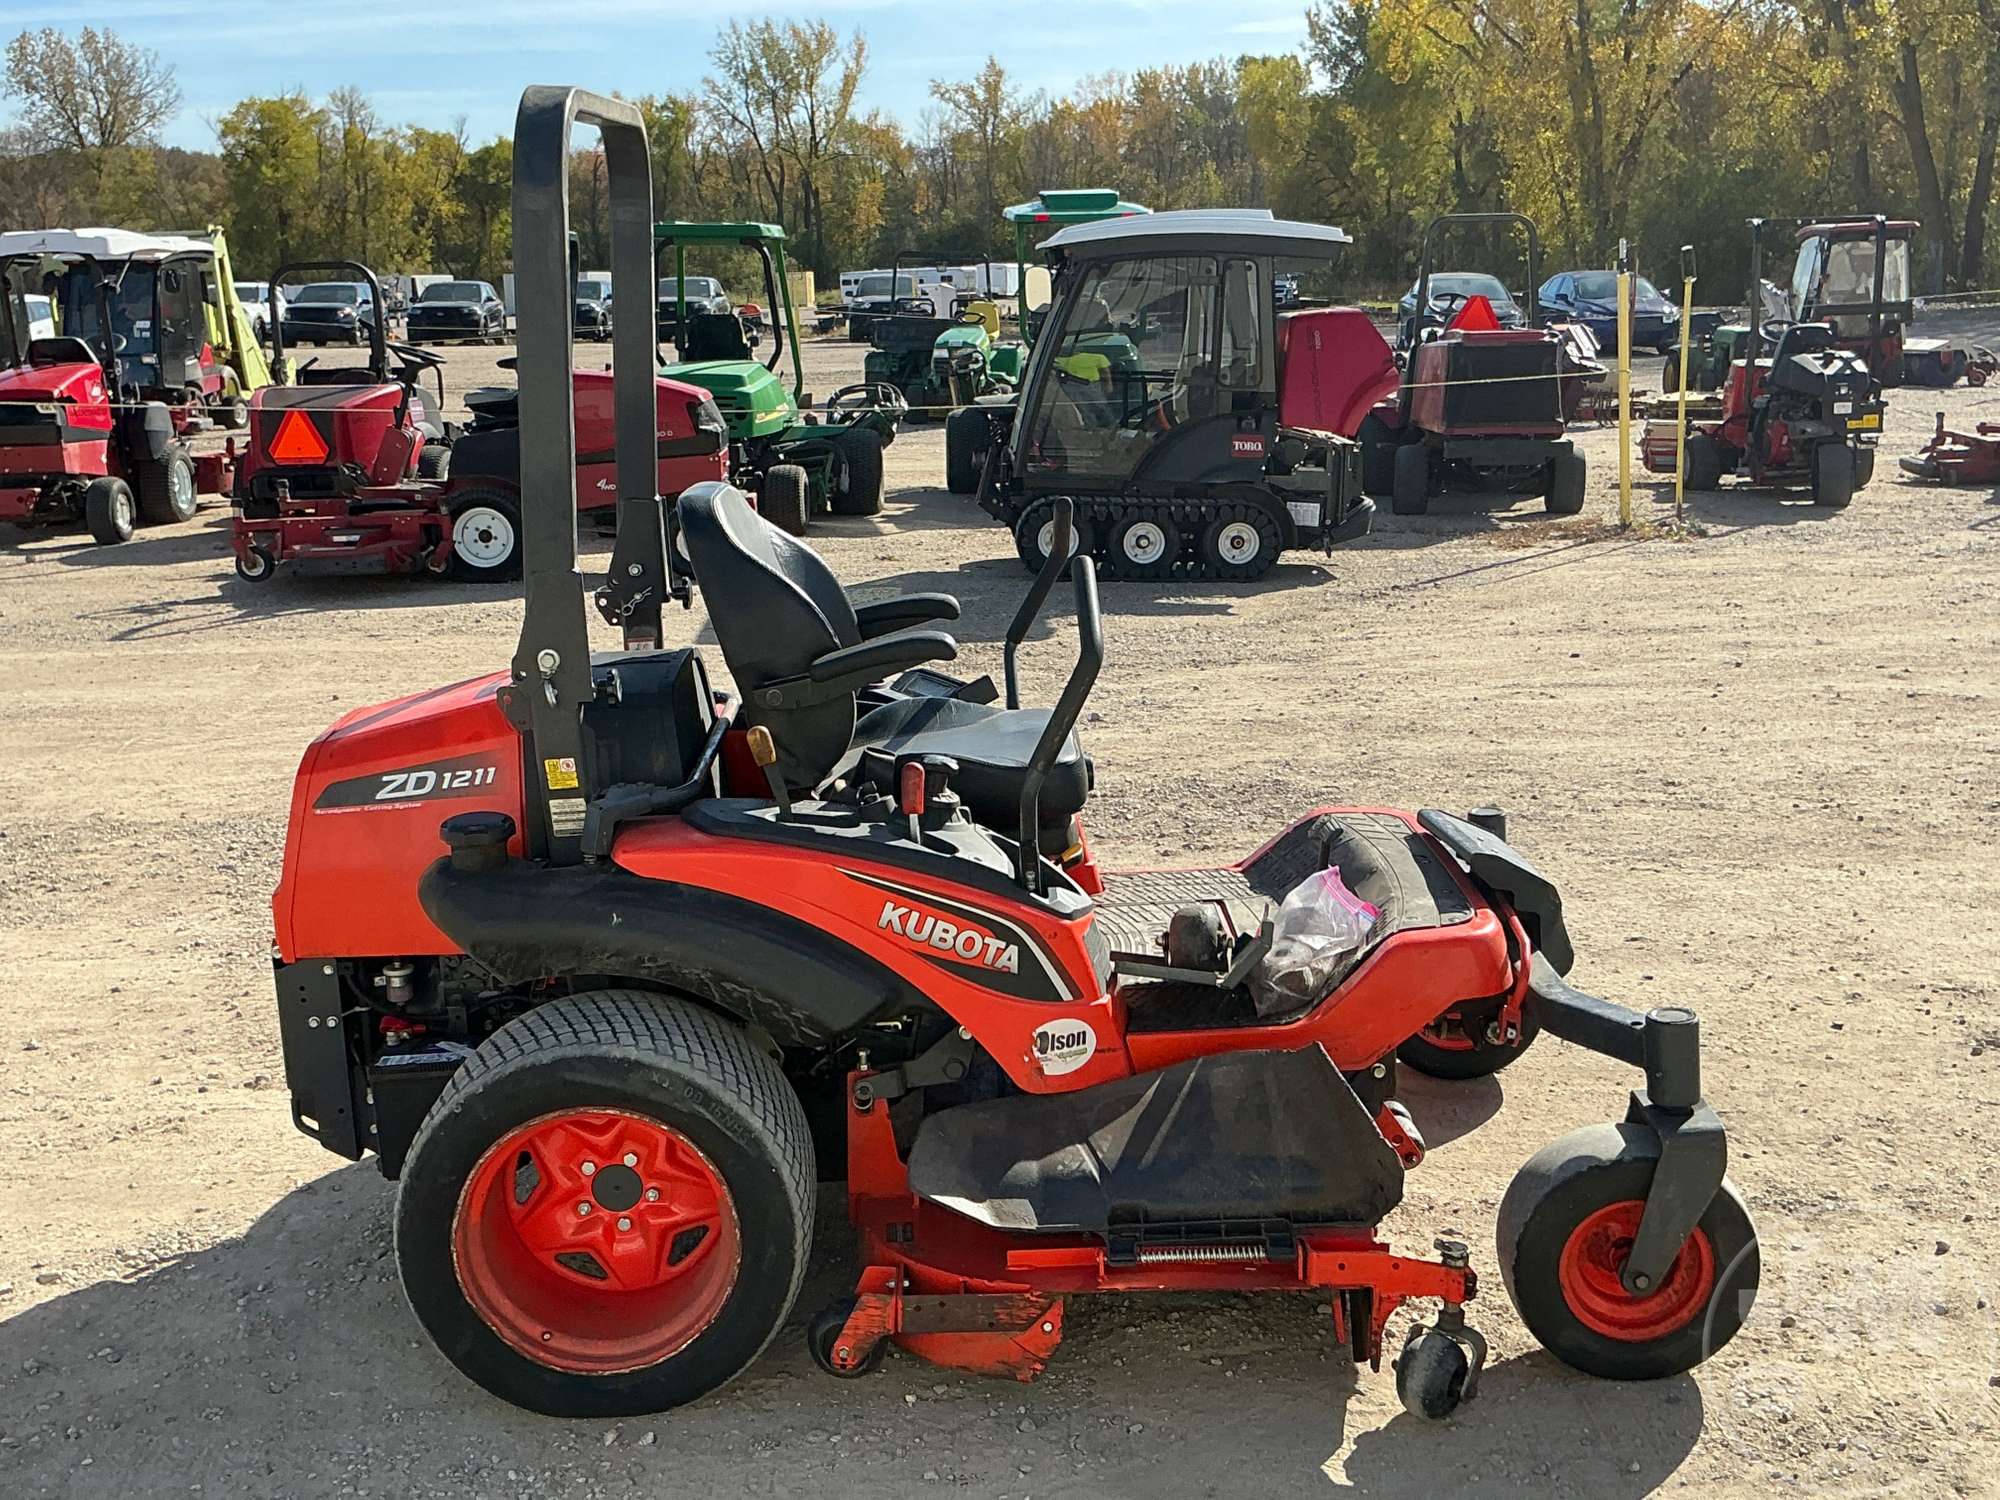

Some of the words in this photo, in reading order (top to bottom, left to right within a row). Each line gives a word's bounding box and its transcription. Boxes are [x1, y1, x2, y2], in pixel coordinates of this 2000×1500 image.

[1233, 441, 1263, 451] TORO
[375, 771, 436, 800] ZD
[442, 767, 496, 789] 1211
[878, 901, 1019, 974] KUBOTA
